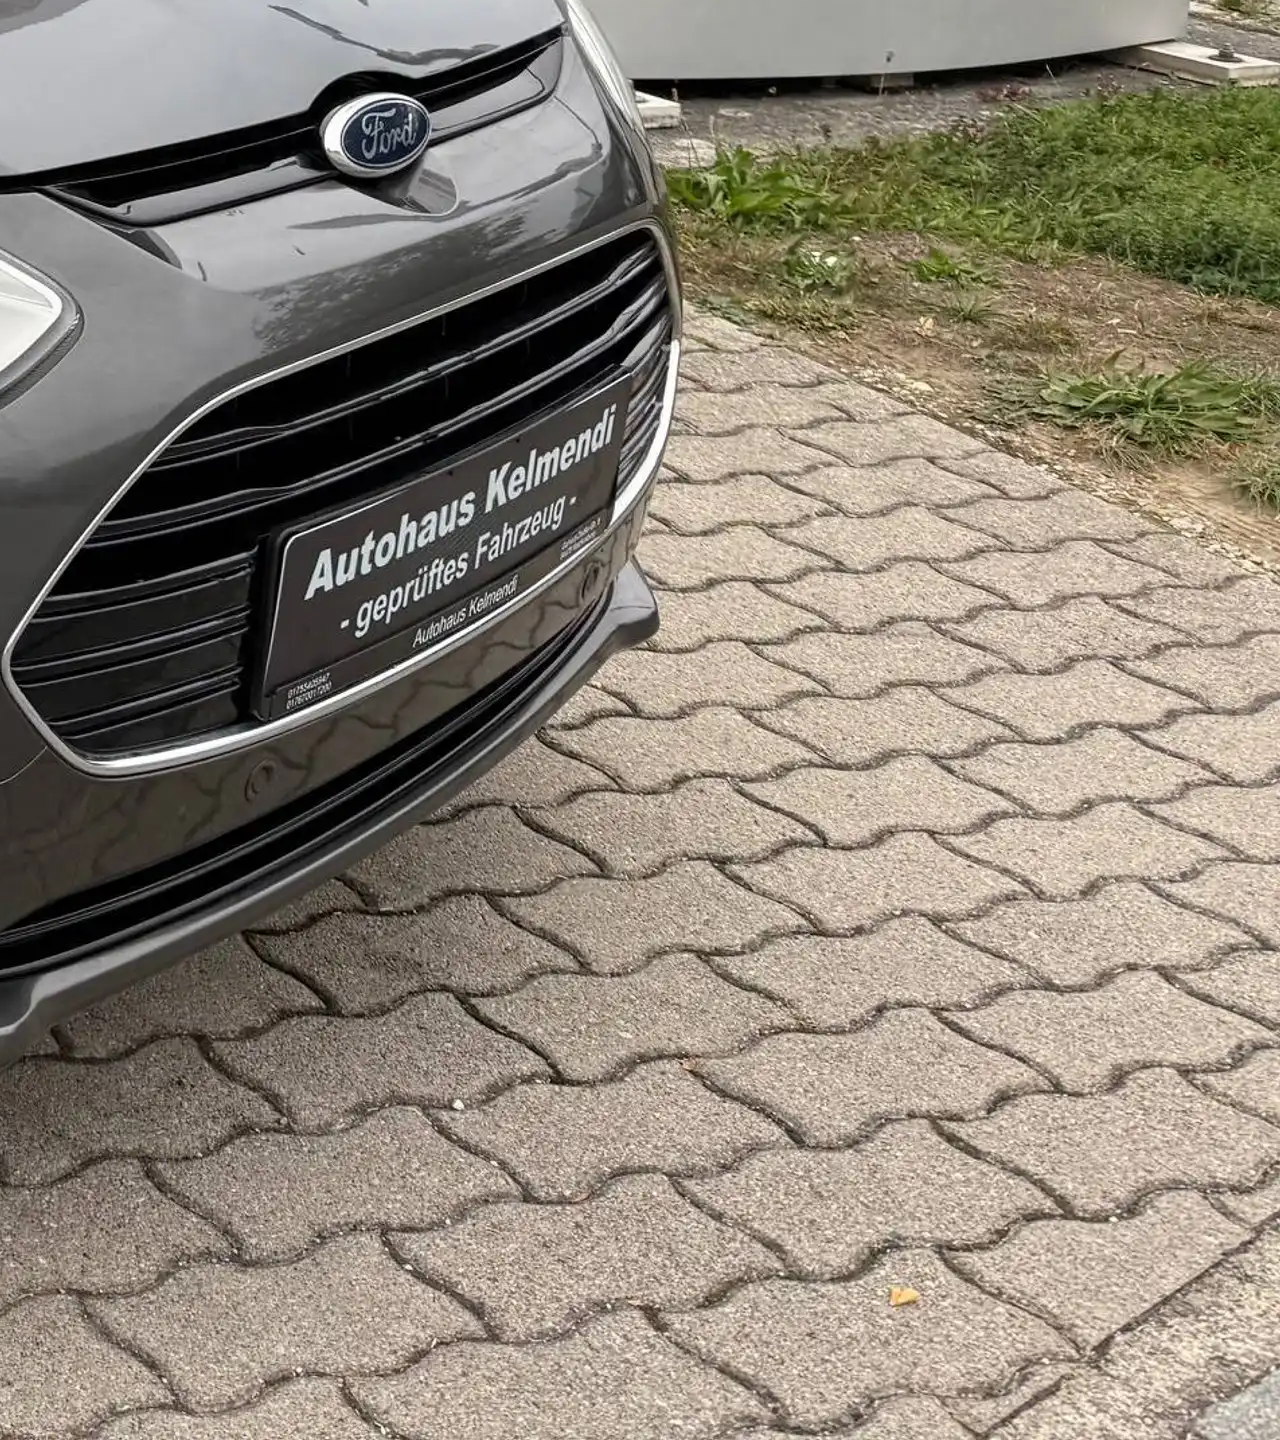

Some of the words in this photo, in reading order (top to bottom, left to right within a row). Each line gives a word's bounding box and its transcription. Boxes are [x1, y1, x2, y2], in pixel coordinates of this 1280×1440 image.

[361, 107, 417, 159] Ford
[303, 490, 477, 601] Autohaus
[485, 403, 618, 514] Kelmendi
[354, 552, 469, 639] geprüftes
[474, 496, 567, 570] Fahrzeug
[412, 607, 467, 649] Autohaus
[468, 574, 519, 617] Kelmendi
